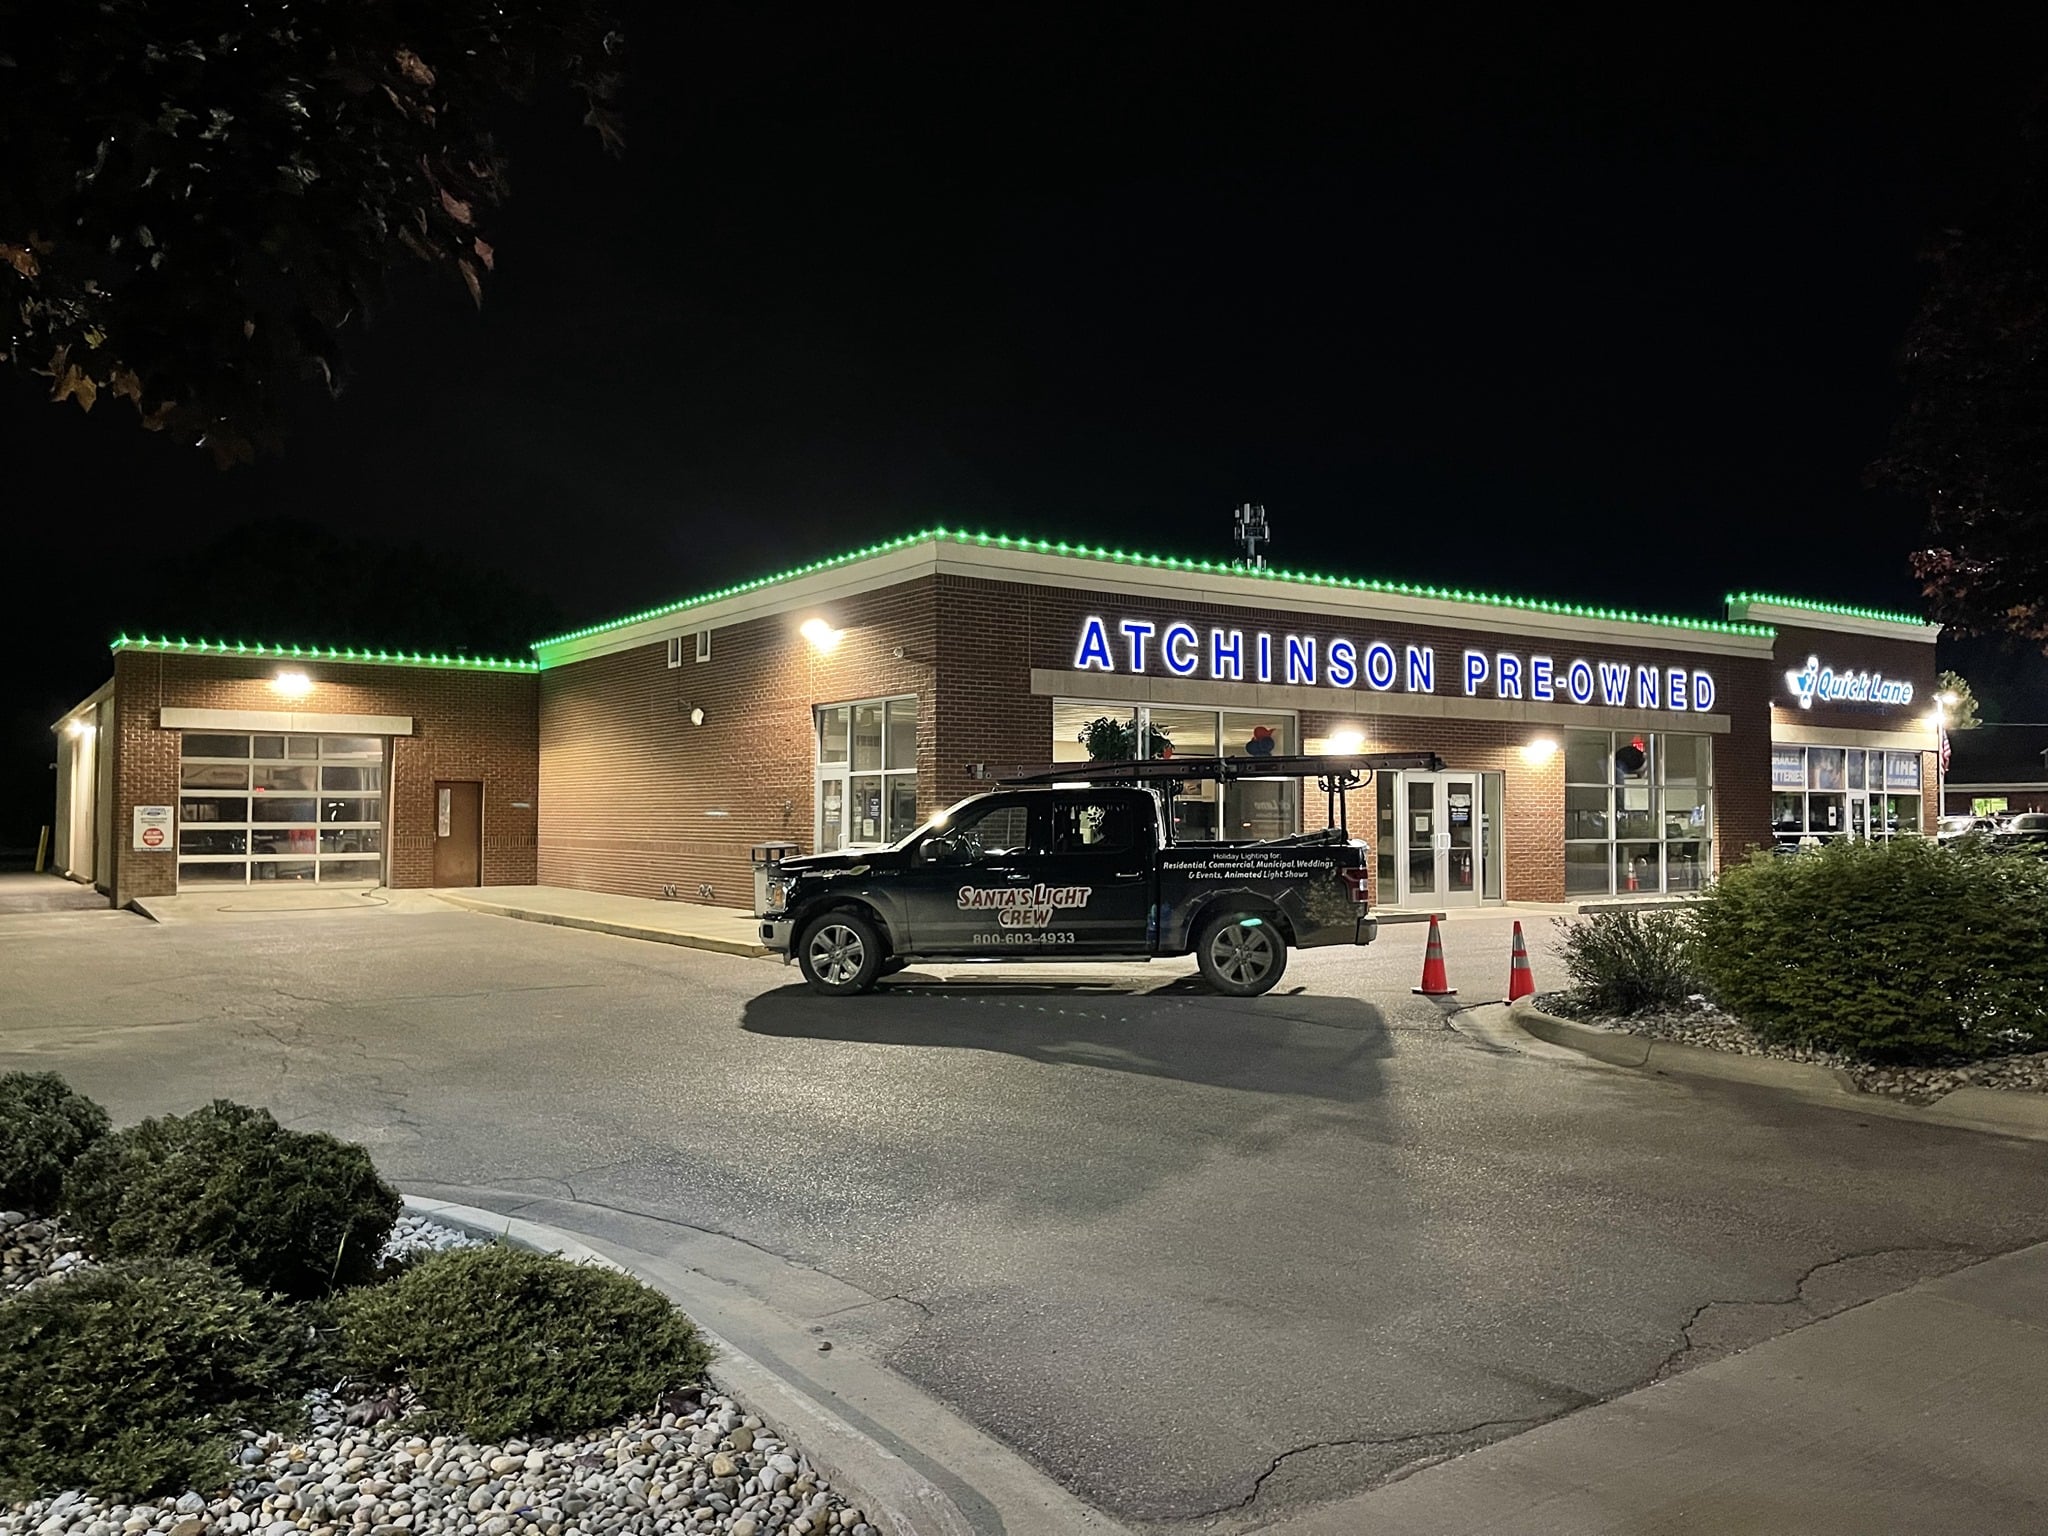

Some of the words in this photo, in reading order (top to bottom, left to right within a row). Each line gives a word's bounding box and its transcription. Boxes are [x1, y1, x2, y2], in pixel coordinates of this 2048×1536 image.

[1074, 616, 1435, 693] ATCHINSON
[1464, 650, 1715, 713] PRE-OWNED
[1818, 668, 1869, 701] Quick
[1869, 674, 1914, 704] Lane
[1163, 861, 1207, 870] Residential,
[1208, 861, 1254, 870] Commercial,
[1296, 860, 1334, 869] Weddings
[1213, 852, 1240, 861] Holiday
[1240, 852, 1268, 861] Lighting
[1188, 871, 1195, 879] &
[1196, 871, 1223, 880] Events,
[1224, 871, 1262, 879] Animated
[1263, 871, 1283, 880] Light
[1284, 870, 1309, 878] Shows
[958, 886, 1033, 909] SANTA'S
[1033, 883, 1092, 908] LIGHT
[998, 907, 1054, 929] CREW
[973, 932, 1076, 945] 800-603-4933
